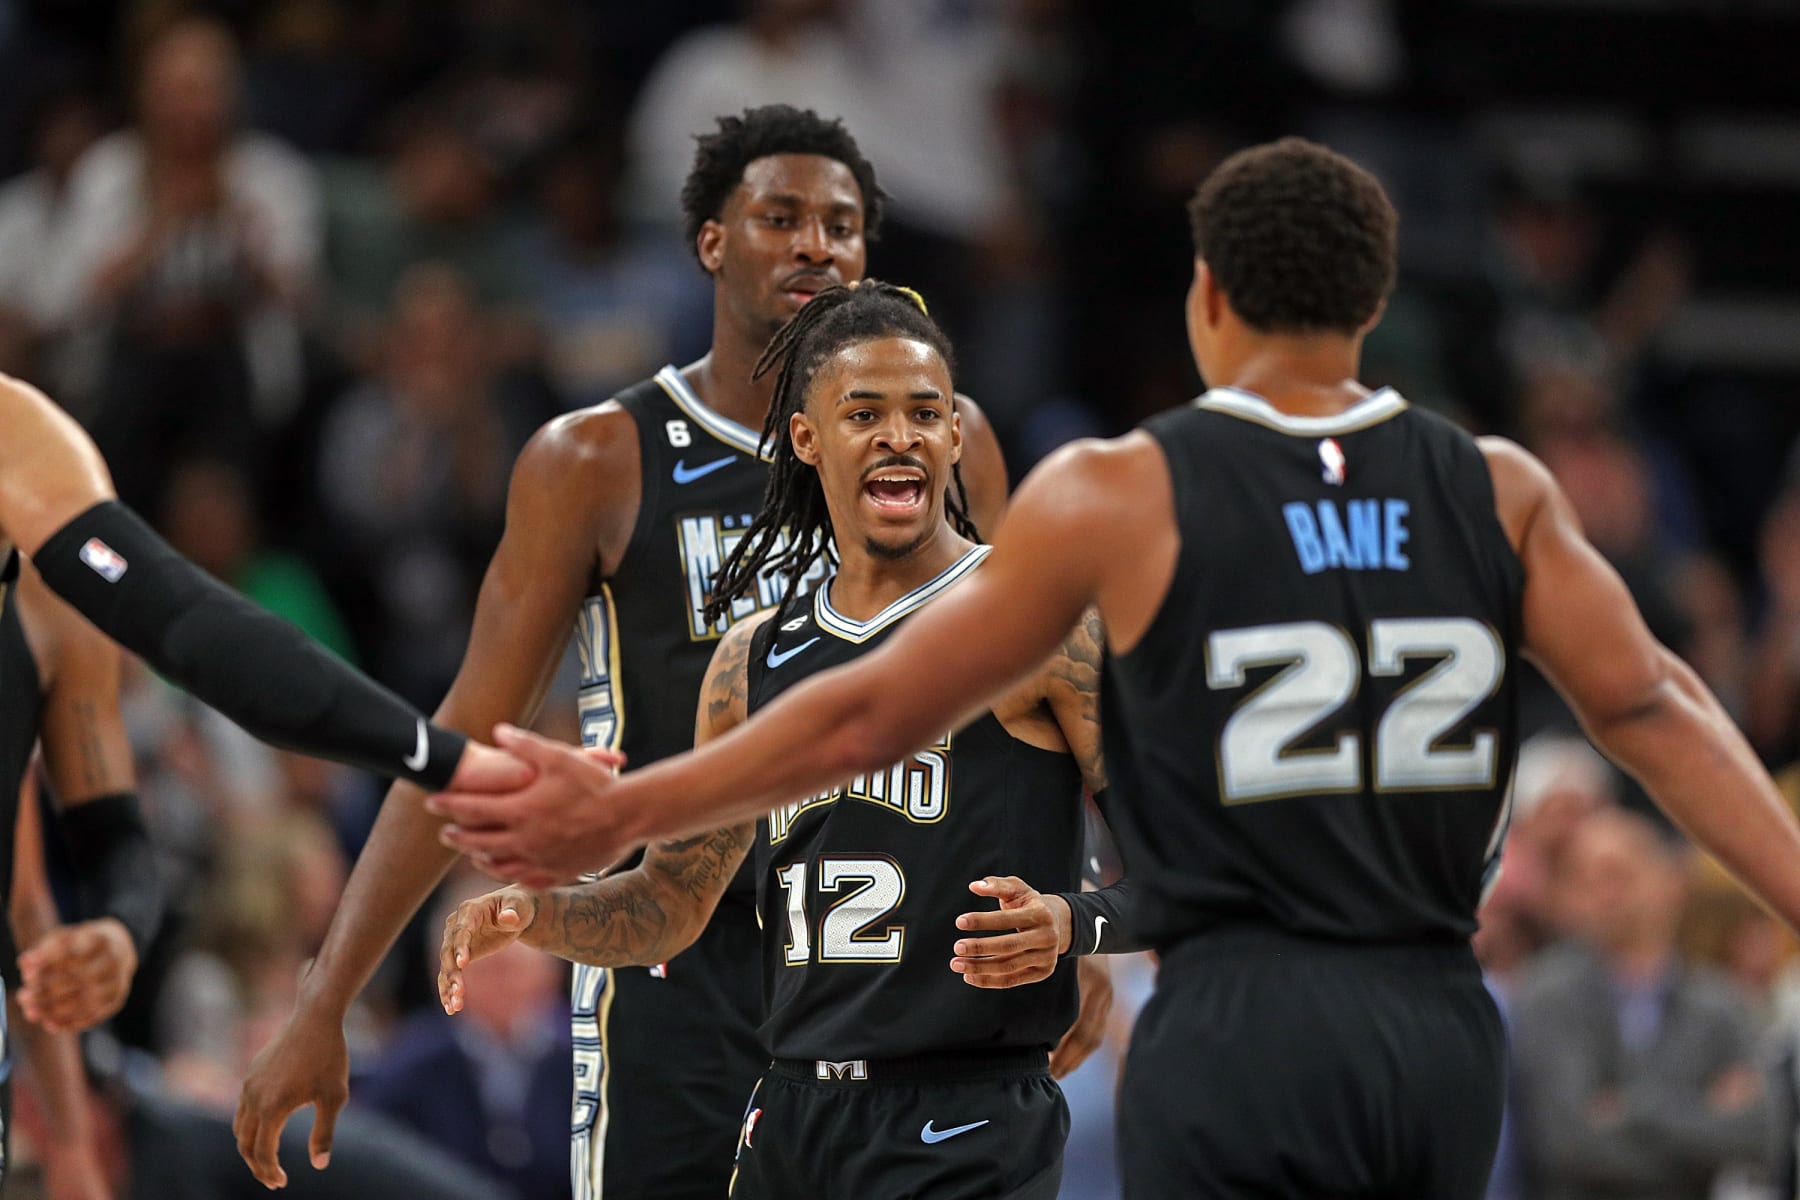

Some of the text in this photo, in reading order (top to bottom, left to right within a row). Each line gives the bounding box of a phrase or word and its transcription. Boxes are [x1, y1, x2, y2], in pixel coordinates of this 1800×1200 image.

[665, 419, 692, 448] 6
[1282, 498, 1411, 575] BANE
[780, 614, 808, 632] 6
[1204, 616, 1506, 807] 22
[776, 853, 905, 966] 12
